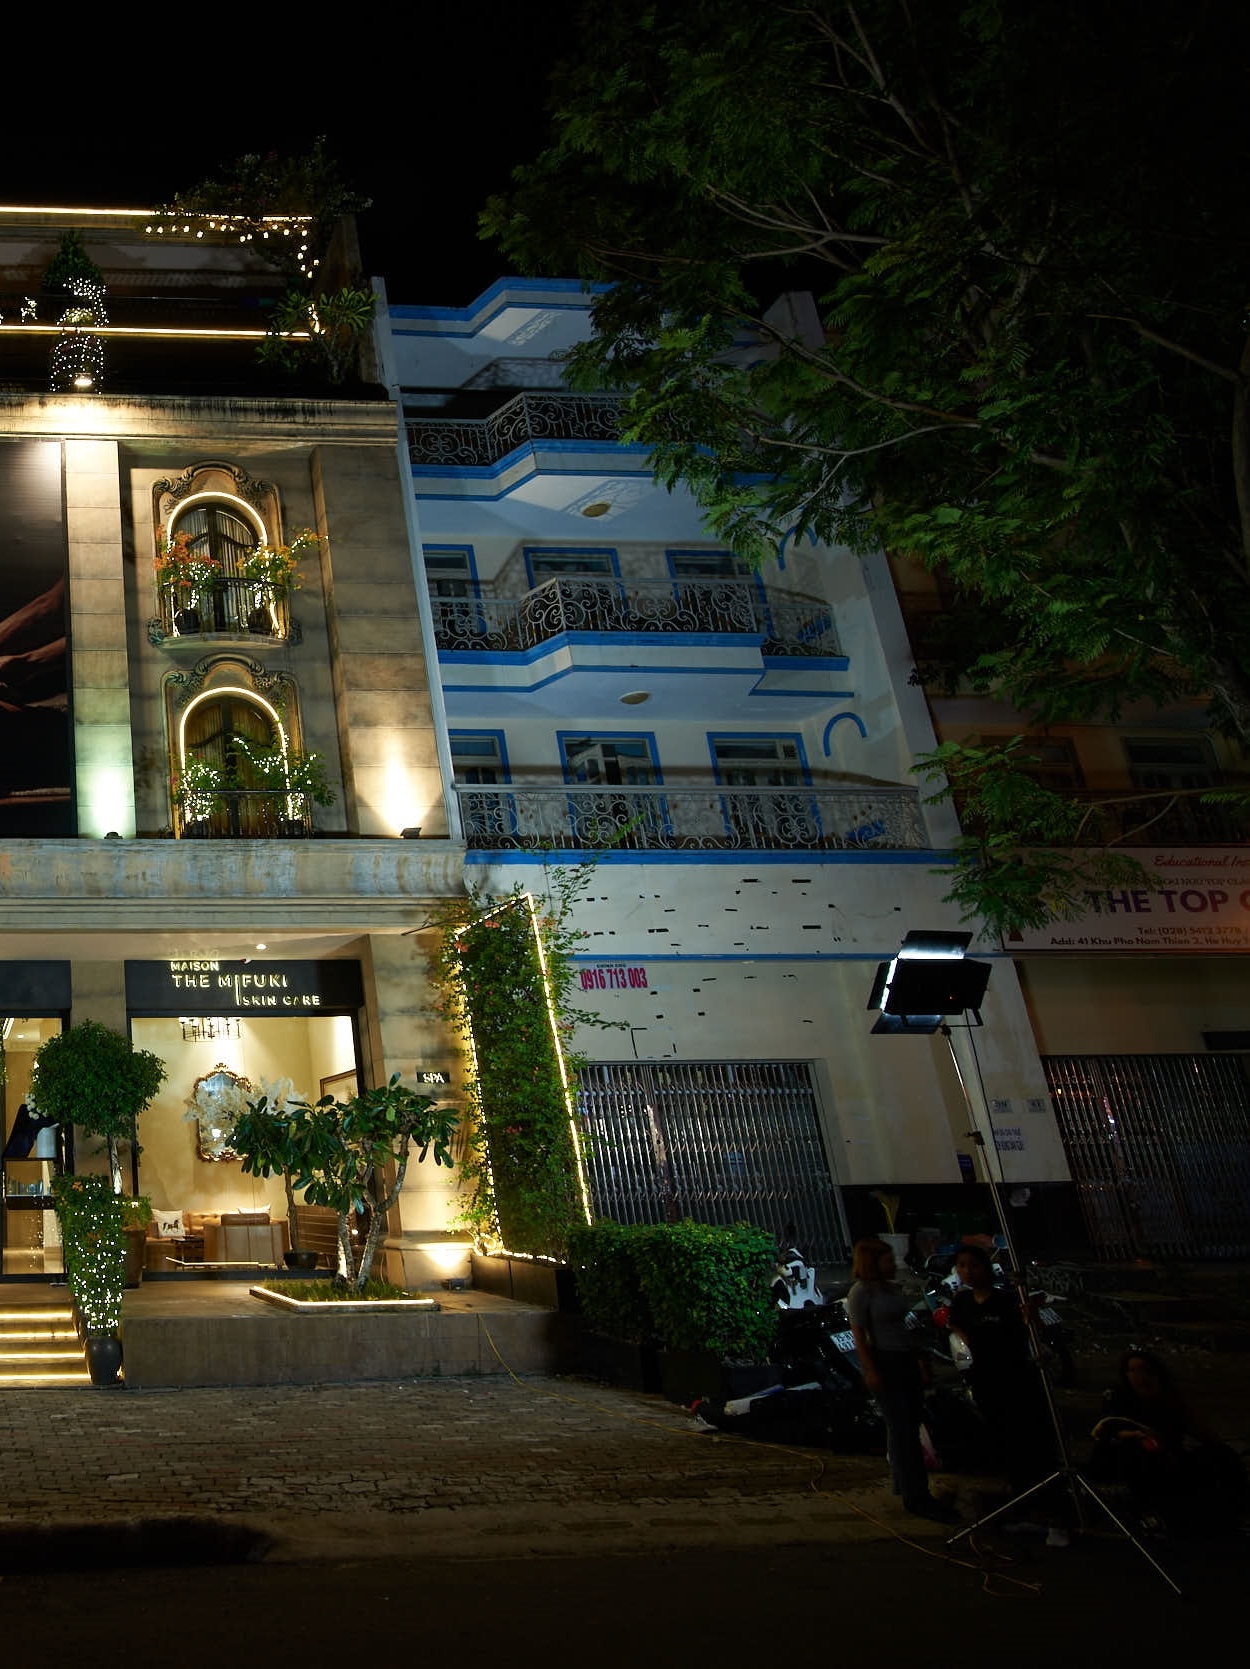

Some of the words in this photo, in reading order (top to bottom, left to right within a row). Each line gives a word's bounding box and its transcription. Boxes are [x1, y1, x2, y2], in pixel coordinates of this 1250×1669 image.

[1085, 889, 1151, 913] THE
[1157, 889, 1229, 913] TOP
[170, 961, 220, 972] MAISON
[171, 974, 210, 988] THE
[580, 969, 607, 990] 0916
[606, 968, 627, 989] 713
[627, 967, 648, 989] 003
[242, 996, 277, 1006] SKIN
[282, 995, 321, 1006] CARE
[422, 1072, 445, 1083] SPA
